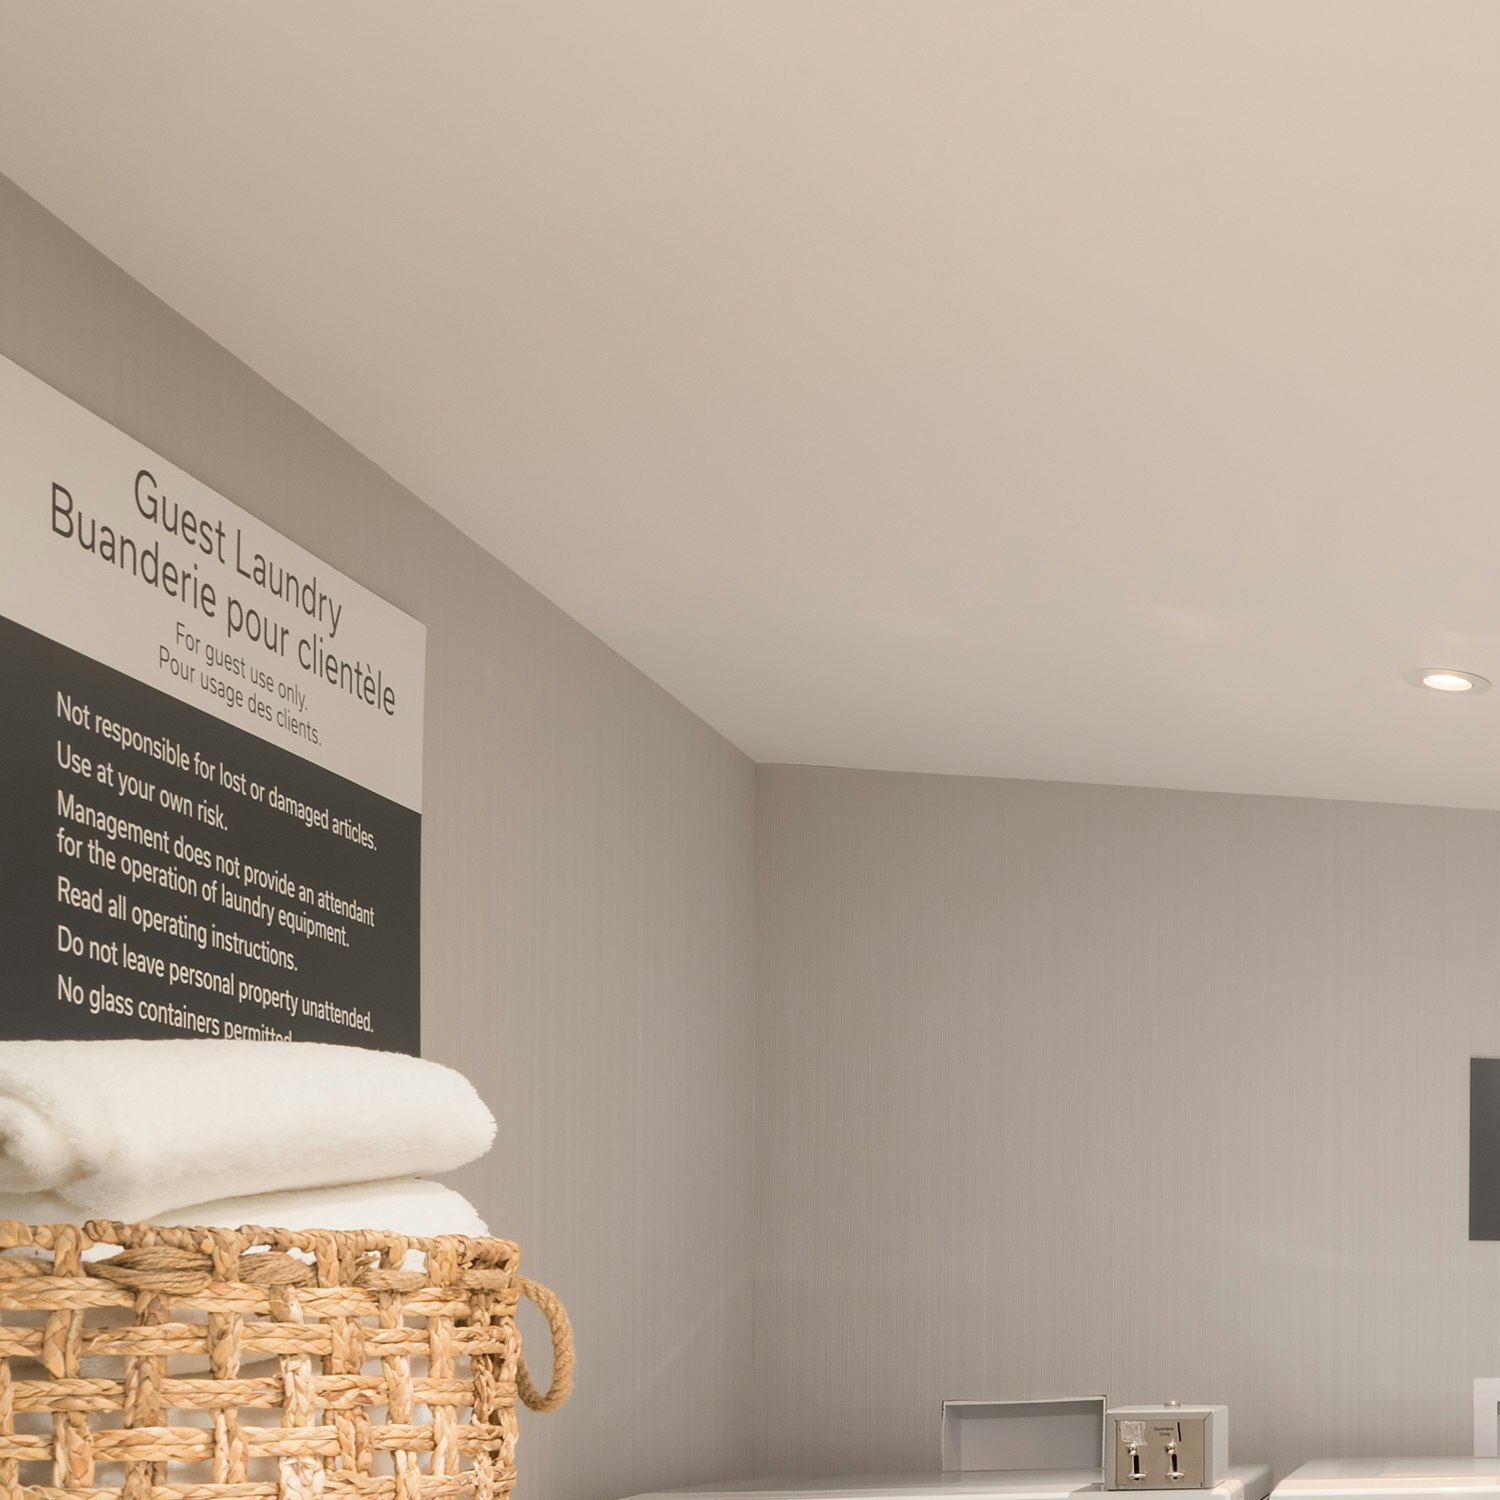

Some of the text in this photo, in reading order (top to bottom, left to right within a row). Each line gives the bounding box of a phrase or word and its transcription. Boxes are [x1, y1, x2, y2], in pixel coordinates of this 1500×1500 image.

[52, 482, 395, 715] Buanderie pour clientèle
[135, 470, 342, 637] Guest Laundry
[160, 646, 322, 746] Pour usage des clients.
[176, 622, 307, 711] For guest use only.
[57, 691, 377, 851] Not responsible for lost or damaged articles.
[57, 741, 228, 831] Use at your own risk.
[57, 790, 375, 928] Management does not provide an attendant
[57, 828, 350, 947] for the operation of laundry equipment.
[58, 877, 298, 972] Read all operating instructions.
[58, 925, 374, 1033] Do not leave personal property unattended.
[58, 974, 84, 1005] No
[89, 985, 134, 1016] glass
[138, 998, 220, 1036] containers
